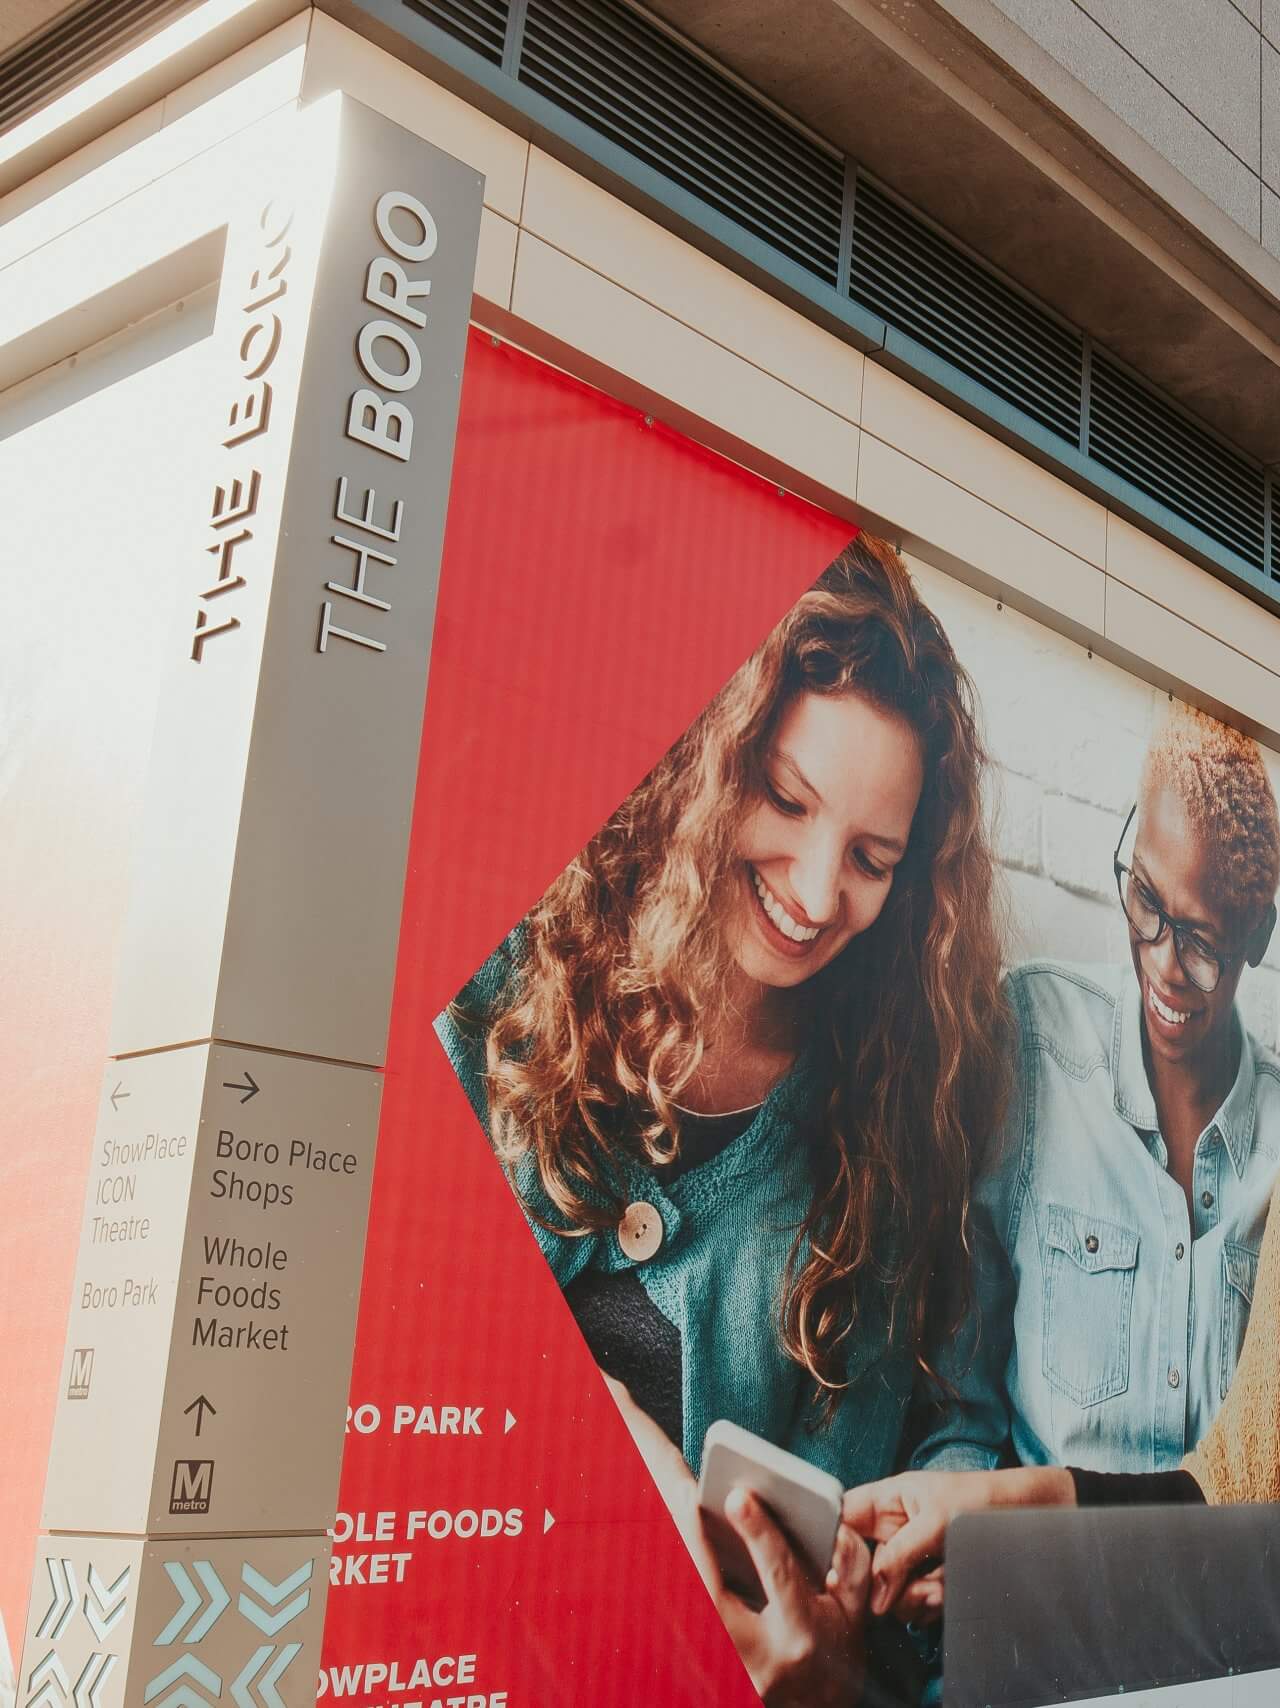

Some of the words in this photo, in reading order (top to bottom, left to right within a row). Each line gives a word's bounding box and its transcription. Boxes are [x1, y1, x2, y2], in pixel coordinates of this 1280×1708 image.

[346, 190, 438, 463] BORO
[190, 470, 262, 665] THE
[318, 476, 404, 653] THE
[101, 1133, 188, 1167] ShowPlace
[216, 1130, 280, 1165] Boro
[288, 1140, 358, 1174] Place
[96, 1175, 136, 1206] ICON
[210, 1169, 295, 1210] Shops
[92, 1216, 150, 1245] Theatre
[203, 1236, 288, 1271] Whole
[81, 1282, 118, 1310] Boro
[122, 1277, 158, 1308] Park
[197, 1276, 281, 1310] Foods
[191, 1317, 289, 1351] Market
[393, 1404, 484, 1435] PARK
[173, 1463, 211, 1500] M
[172, 1500, 207, 1511] metro
[406, 1508, 523, 1540] FOODS
